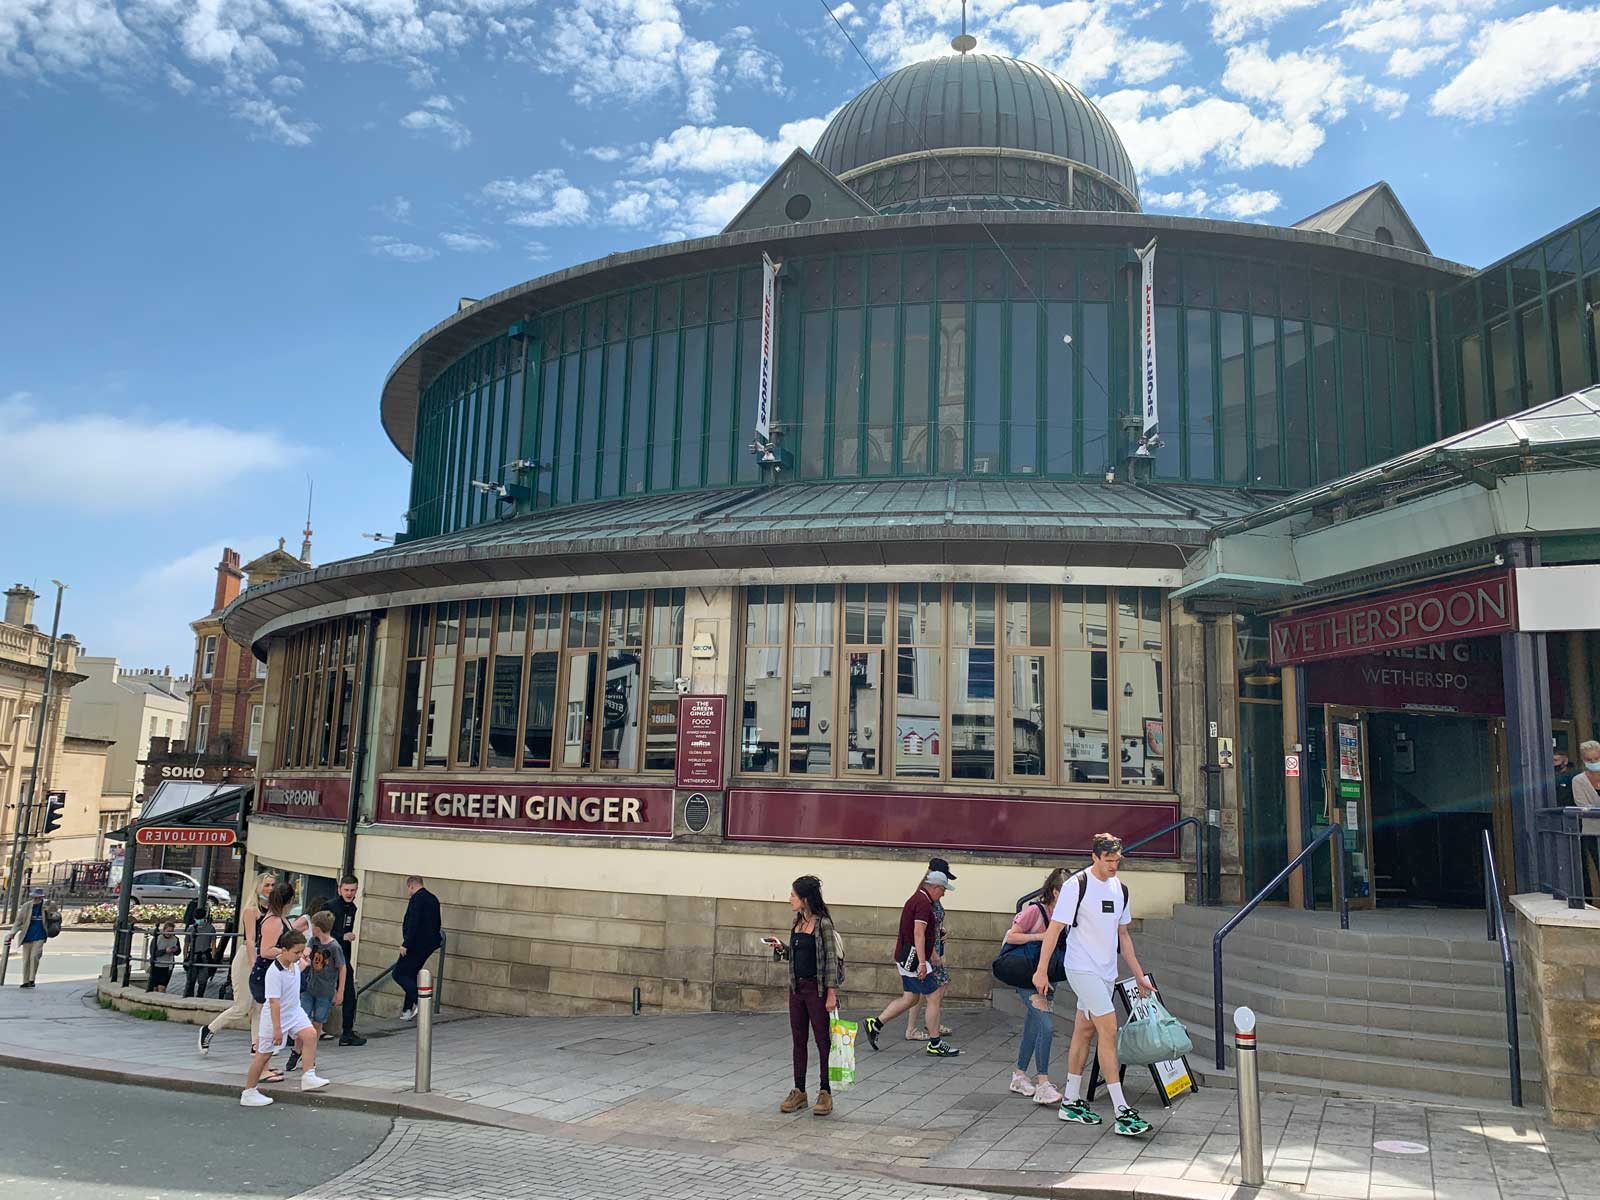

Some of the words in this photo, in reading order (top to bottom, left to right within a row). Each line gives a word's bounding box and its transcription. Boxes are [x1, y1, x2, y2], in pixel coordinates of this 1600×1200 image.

[1274, 583, 1506, 657] WETHERSPOON
[161, 766, 205, 778] SOHO
[388, 791, 429, 815] THE
[434, 793, 518, 819] GREEN
[525, 795, 641, 823] GINGER
